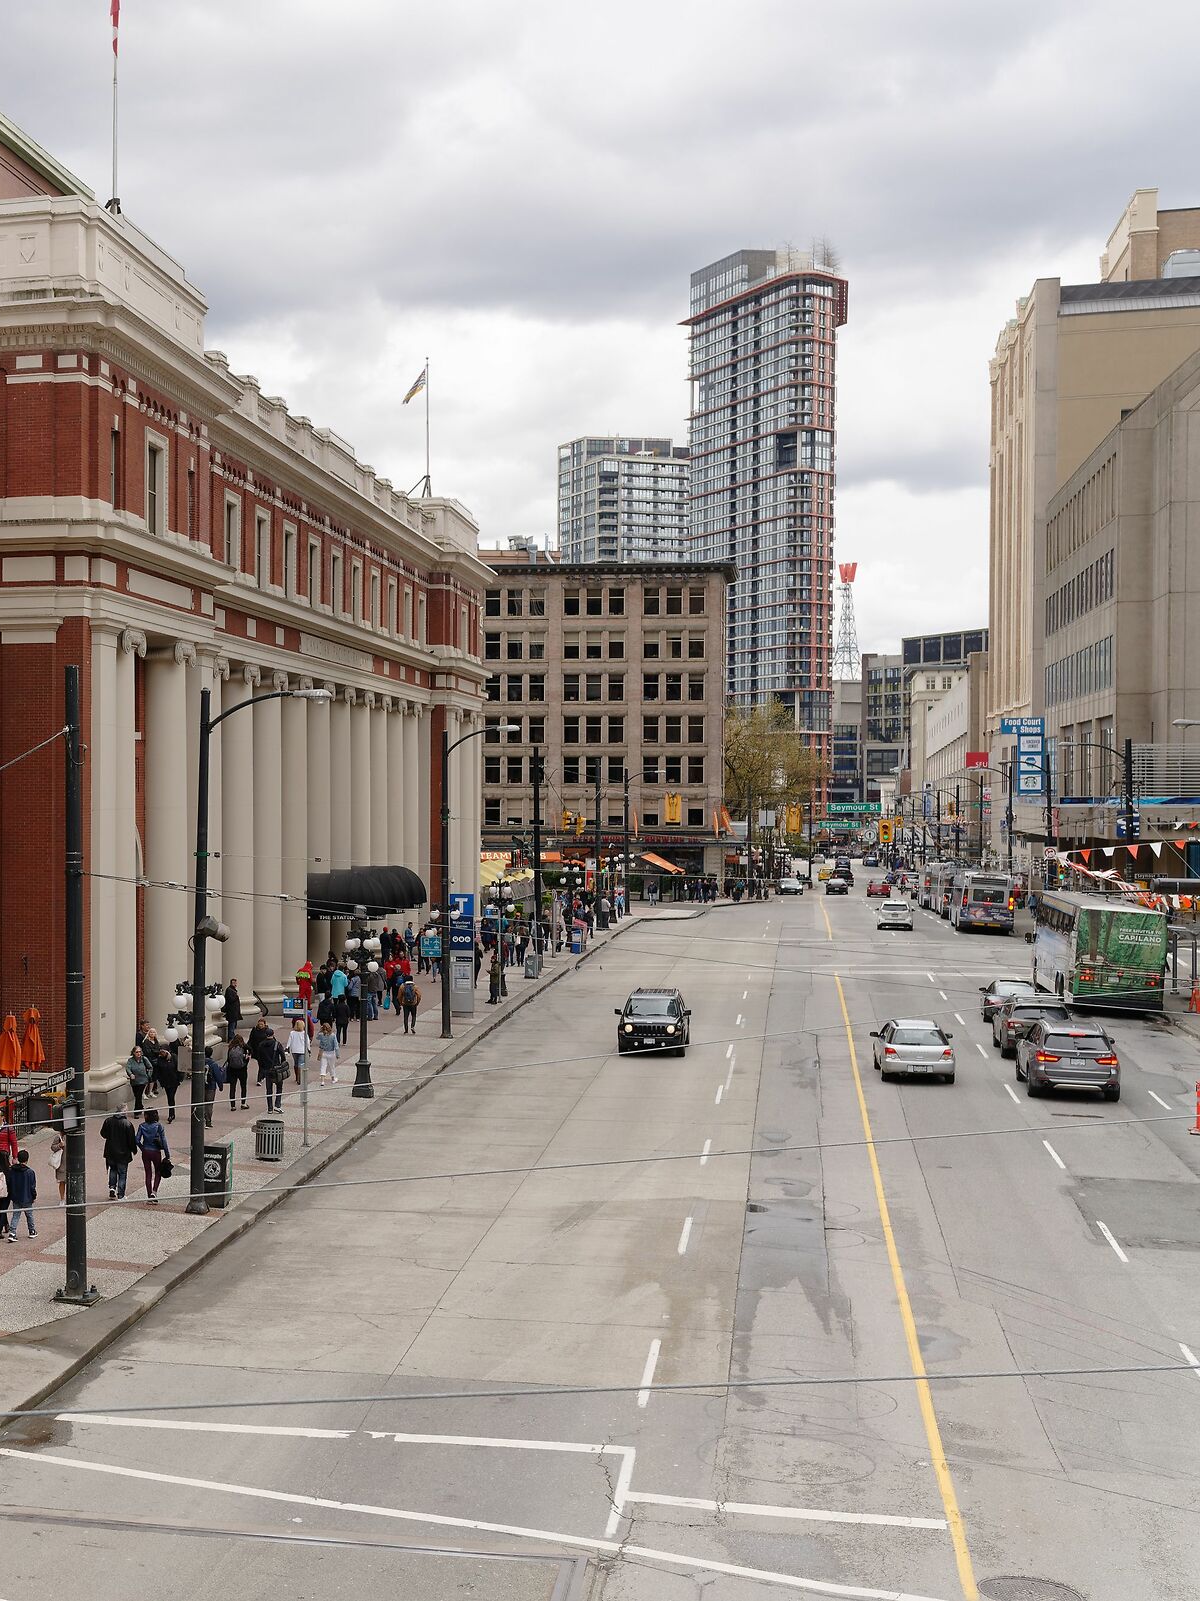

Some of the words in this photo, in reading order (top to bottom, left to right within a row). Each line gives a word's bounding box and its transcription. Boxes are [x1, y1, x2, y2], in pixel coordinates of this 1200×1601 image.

[1004, 718, 1021, 726] Food
[1022, 718, 1041, 726] Court
[1020, 726, 1041, 734] Shops
[830, 804, 866, 813] Seymour
[870, 803, 878, 811] St
[454, 897, 469, 914] T
[1119, 934, 1161, 943] CAPILANO
